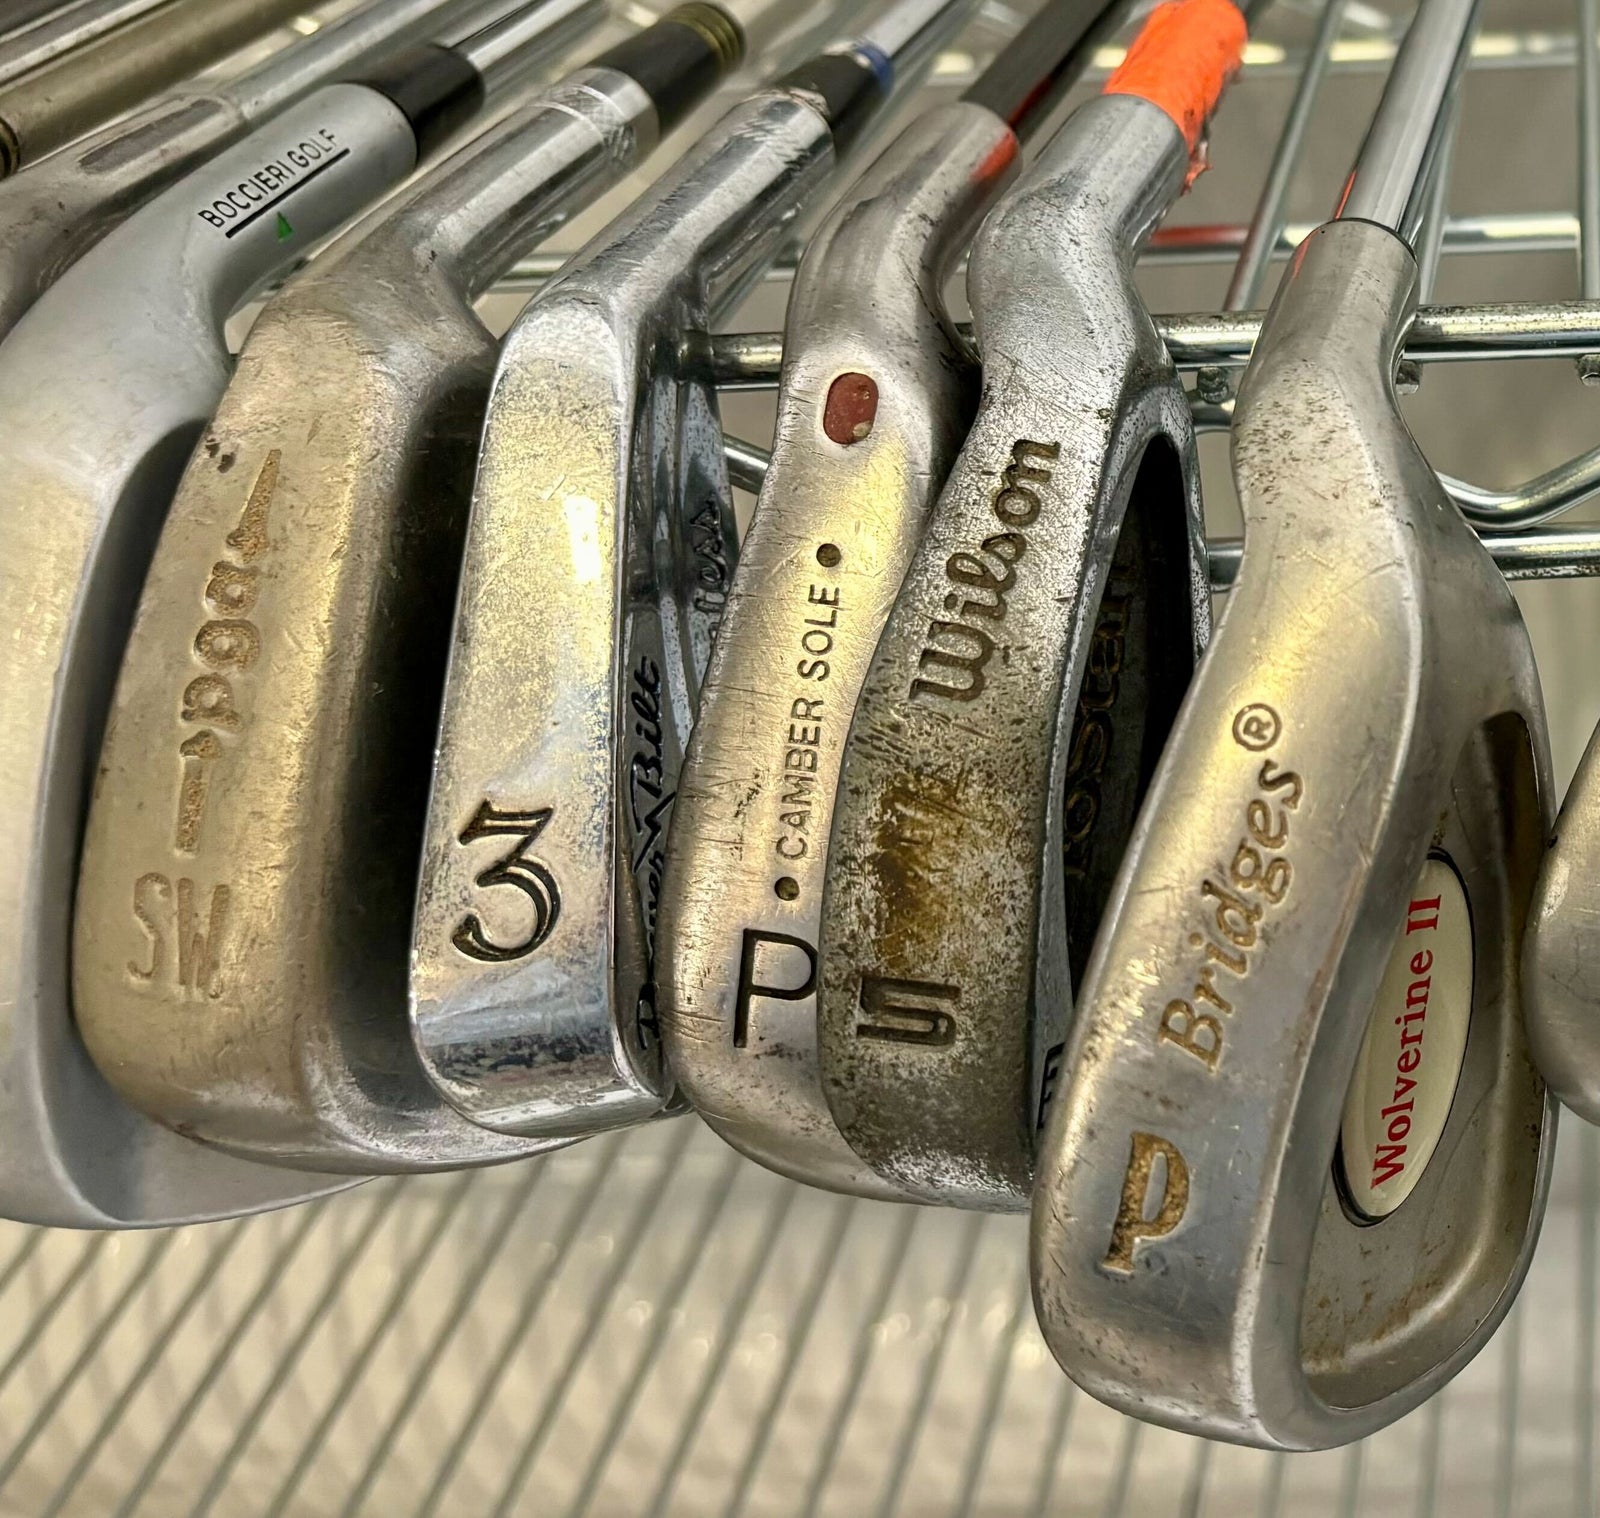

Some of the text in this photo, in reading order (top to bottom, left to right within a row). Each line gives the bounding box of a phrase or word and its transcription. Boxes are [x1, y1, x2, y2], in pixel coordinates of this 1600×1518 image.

[197, 128, 336, 228] BOCCIERI GOLF
[909, 438, 1062, 703] Wilson
[777, 585, 840, 861] CAMBER SOLE
[127, 872, 231, 999] SW
[451, 799, 563, 963] 3
[734, 927, 817, 1050] P
[857, 974, 962, 1047] 5
[1371, 895, 1442, 1190] Wolverine II
[1102, 1131, 1190, 1276] P
